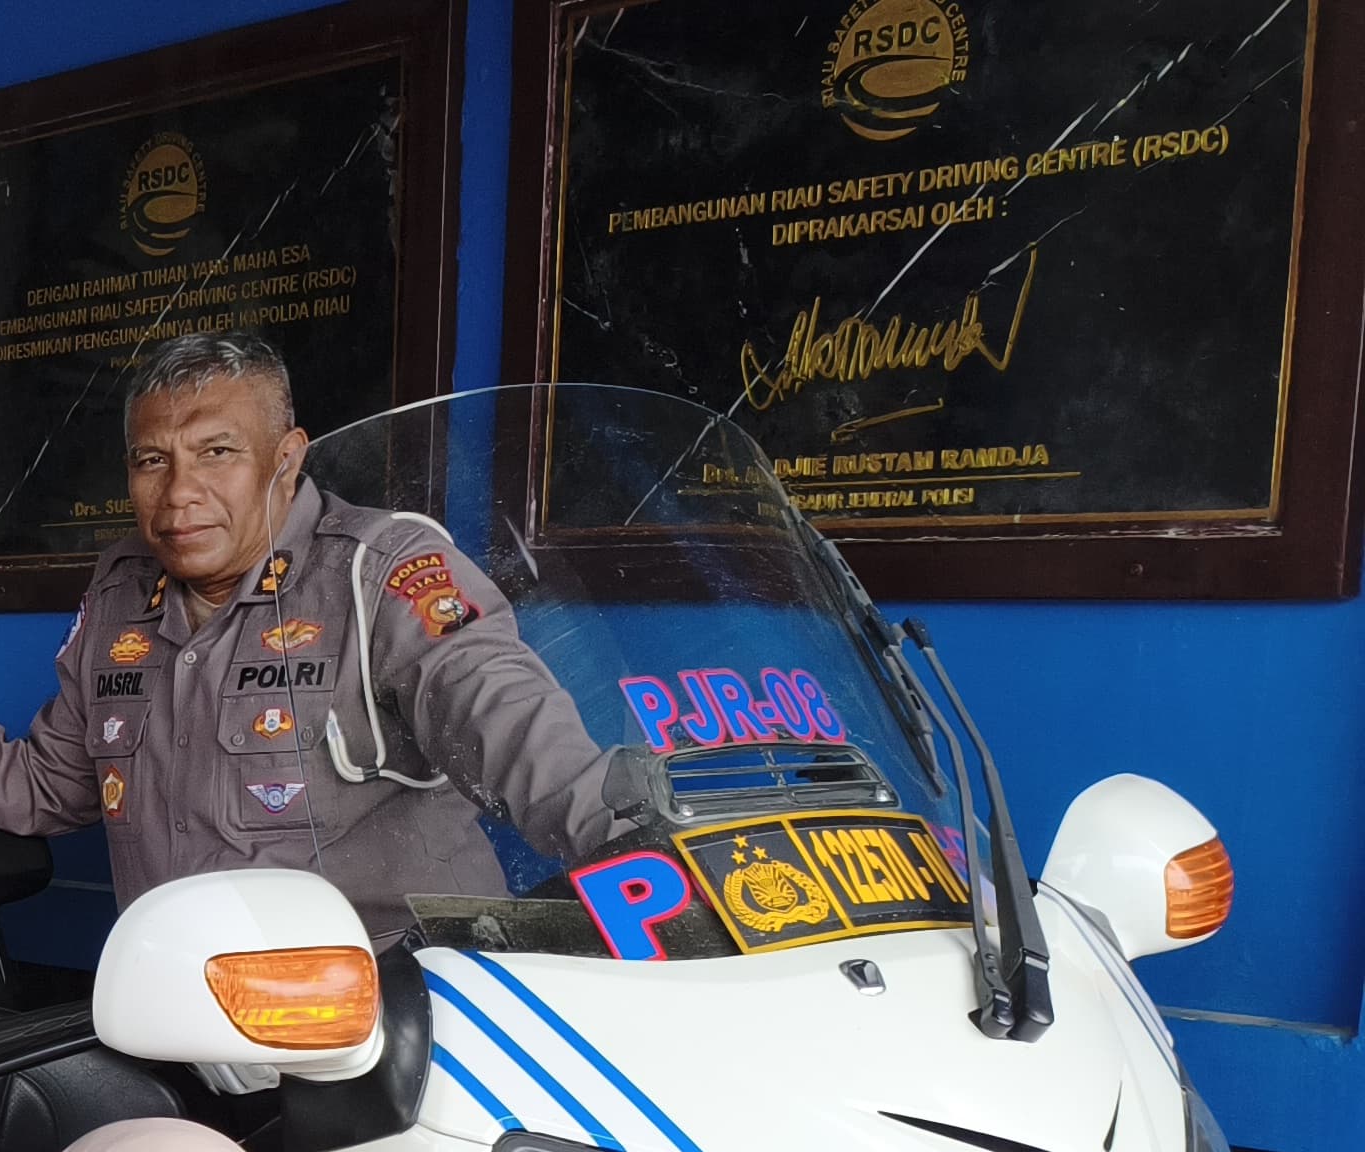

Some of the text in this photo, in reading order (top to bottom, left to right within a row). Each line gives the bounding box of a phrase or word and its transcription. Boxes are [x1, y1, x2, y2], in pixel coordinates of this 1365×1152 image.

[854, 15, 941, 57] RSDC
[138, 161, 190, 192] RSDC
[608, 124, 1229, 233] PEMBANGUNAN RIAU SAFETY DRIVING CENTRE (RSDC)
[772, 205, 925, 246] DIPRAKARSAI
[931, 196, 994, 226] OLEH
[27, 243, 311, 307] DENGAN RAHMAT TUHAN YANG MAHA ESA
[90, 301, 121, 323] RIAU
[124, 293, 175, 318] SAFETY
[179, 284, 237, 309] DRIVING
[240, 274, 299, 298] CENTRE
[302, 265, 357, 294] (RSDC)
[197, 311, 234, 334] OLEH
[239, 302, 309, 331] KAPOLDA
[313, 294, 350, 317] RIAU
[833, 450, 934, 474] RUSTAM
[941, 445, 1050, 471] RAMDJA
[74, 499, 134, 517] Drs. SUE
[921, 487, 975, 506] POLISI
[390, 556, 441, 588] POLDA
[406, 573, 447, 596] RIAU
[97, 671, 143, 698] DASRIL
[237, 662, 326, 691] POLRI
[619, 668, 846, 754] PJR-08
